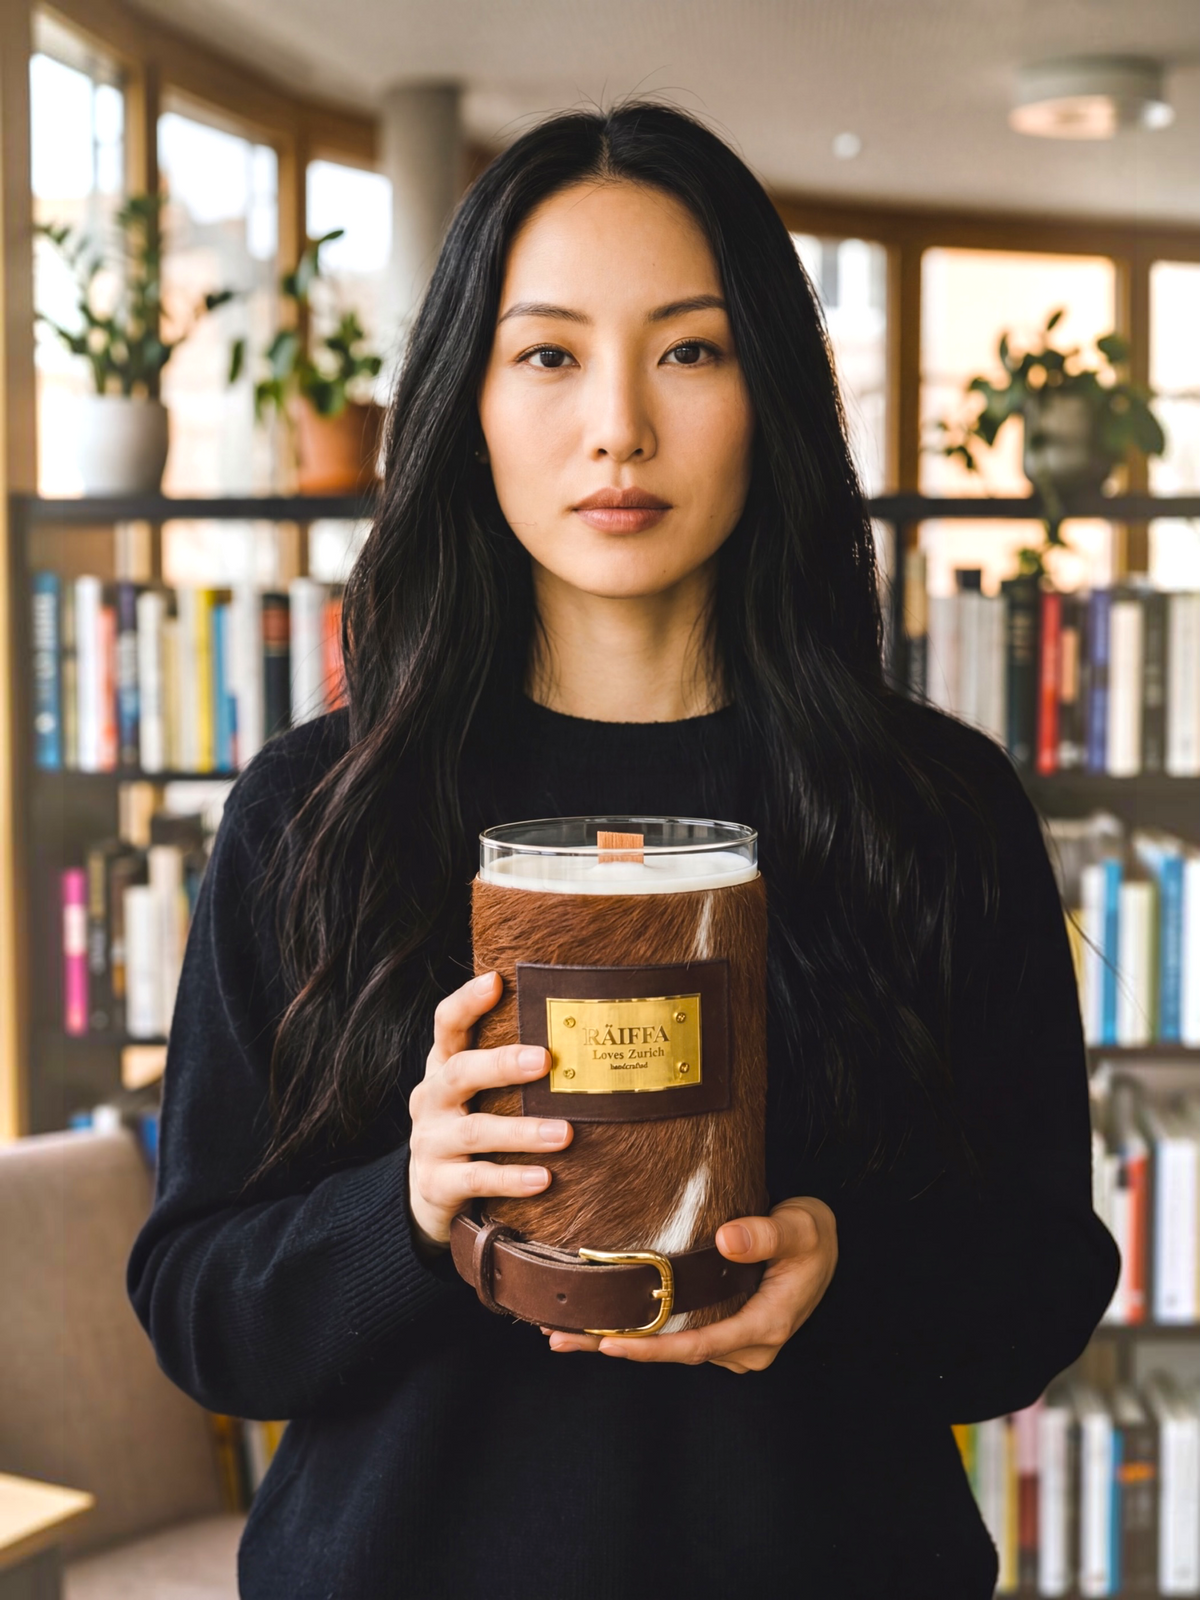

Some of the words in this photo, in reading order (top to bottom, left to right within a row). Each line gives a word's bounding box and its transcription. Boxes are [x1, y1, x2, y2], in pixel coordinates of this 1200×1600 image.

[583, 1024, 670, 1046] RÄIFFA
[592, 1049, 624, 1060] Loves
[628, 1047, 665, 1059] Zurich
